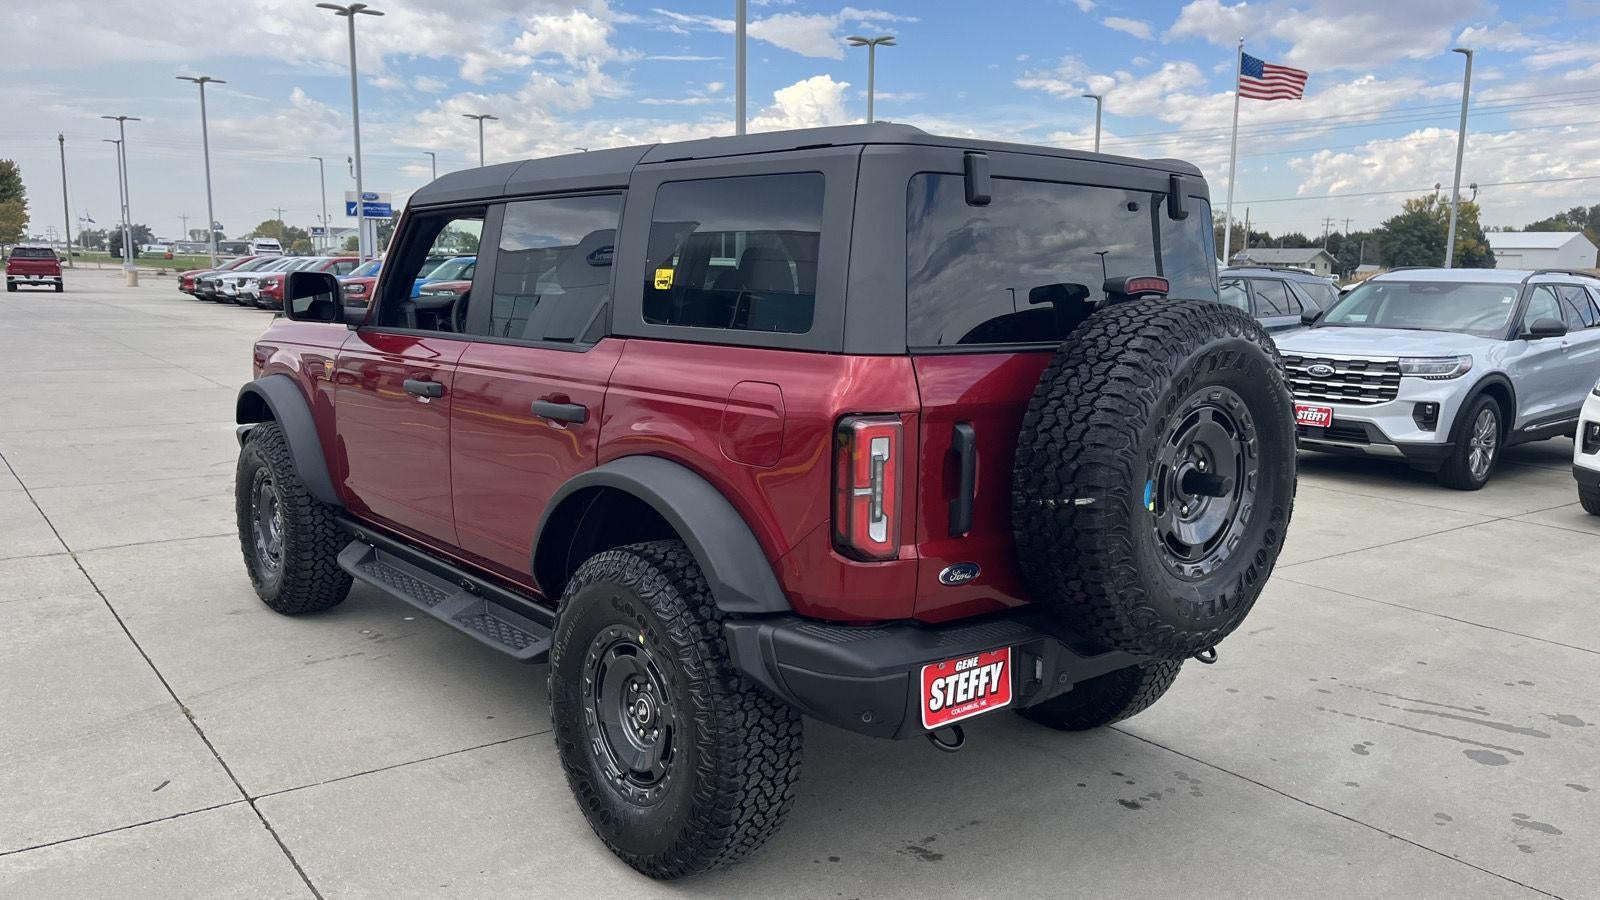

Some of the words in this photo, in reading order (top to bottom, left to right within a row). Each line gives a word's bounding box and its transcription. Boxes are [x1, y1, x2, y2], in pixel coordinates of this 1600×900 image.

[1296, 410, 1328, 422] STEFFY
[955, 656, 979, 672] GENE
[928, 661, 1005, 711] STEFFY
